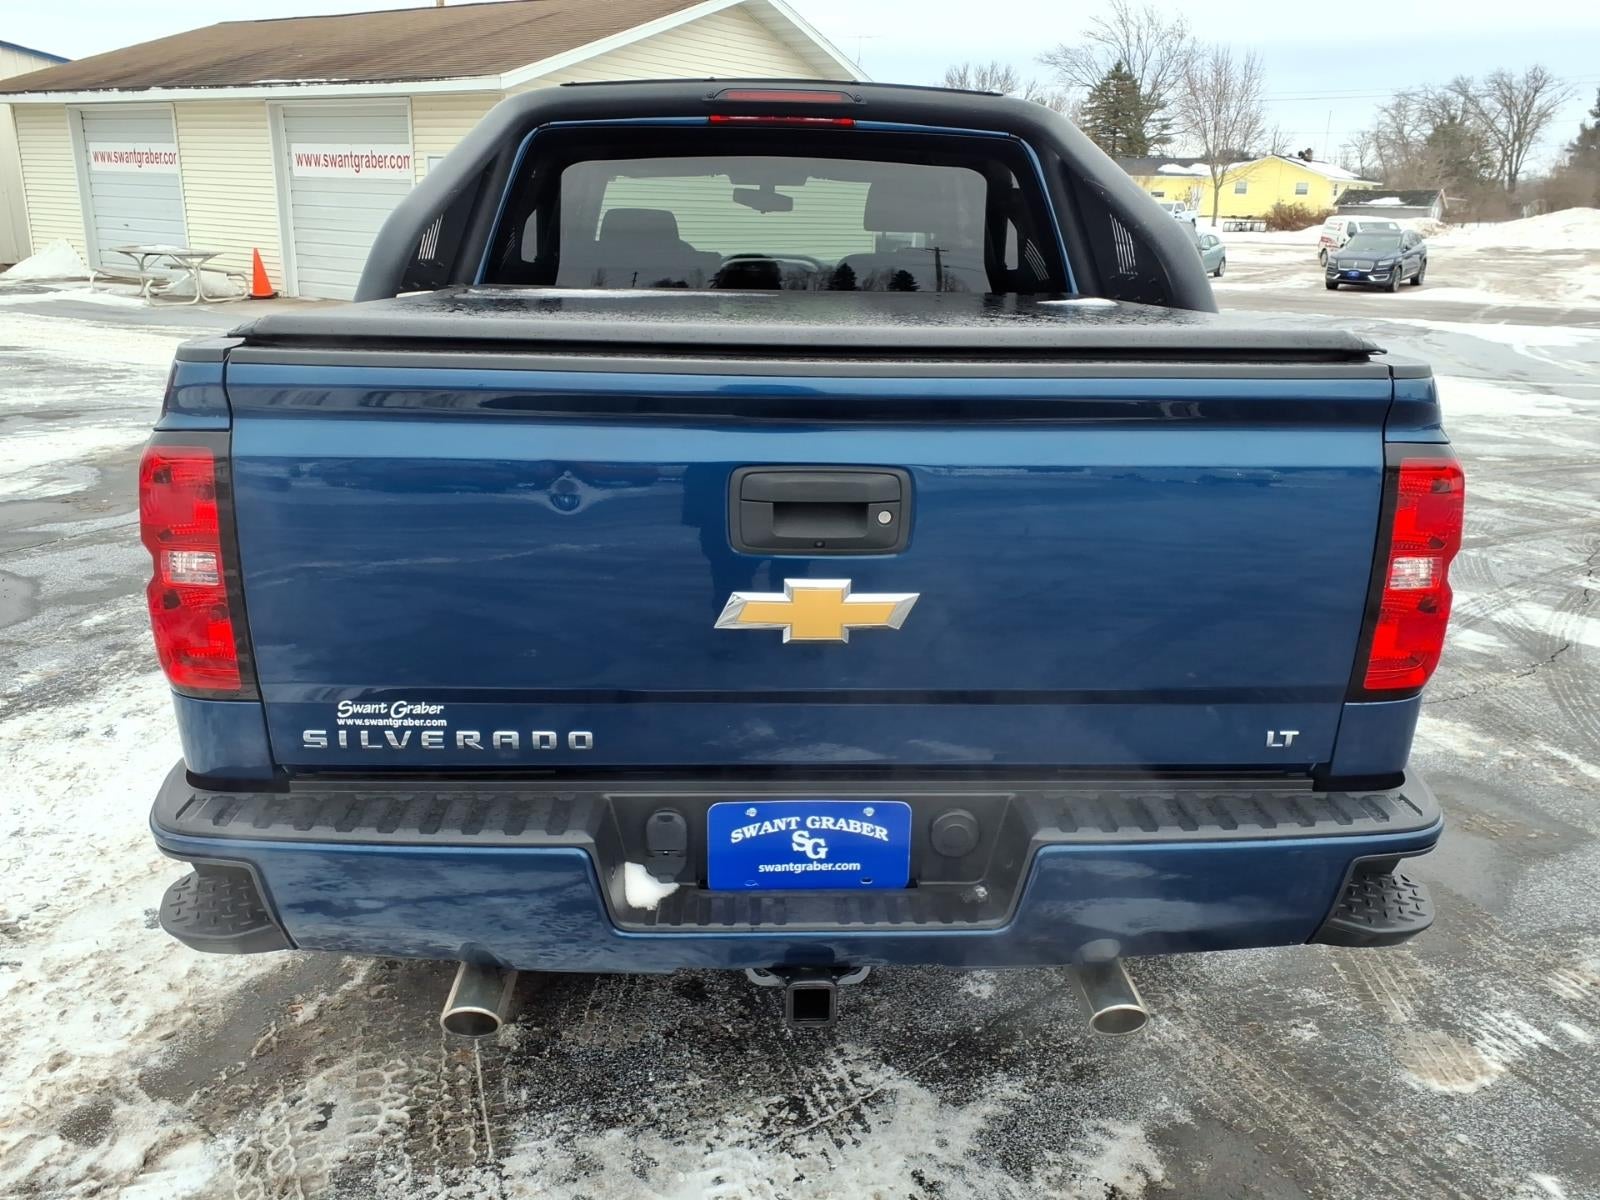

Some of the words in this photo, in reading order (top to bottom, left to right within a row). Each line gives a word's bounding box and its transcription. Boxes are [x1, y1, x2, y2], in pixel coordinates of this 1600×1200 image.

[337, 700, 388, 718] Swant
[390, 700, 445, 719] Graber
[336, 717, 448, 728] www.swantgraber.com
[302, 729, 594, 750] SILVERADO
[1266, 730, 1300, 747] LT
[730, 816, 801, 844] SWANT
[806, 815, 889, 842] GRABER
[791, 830, 829, 860] SG
[758, 861, 861, 874] swantgraber.com
